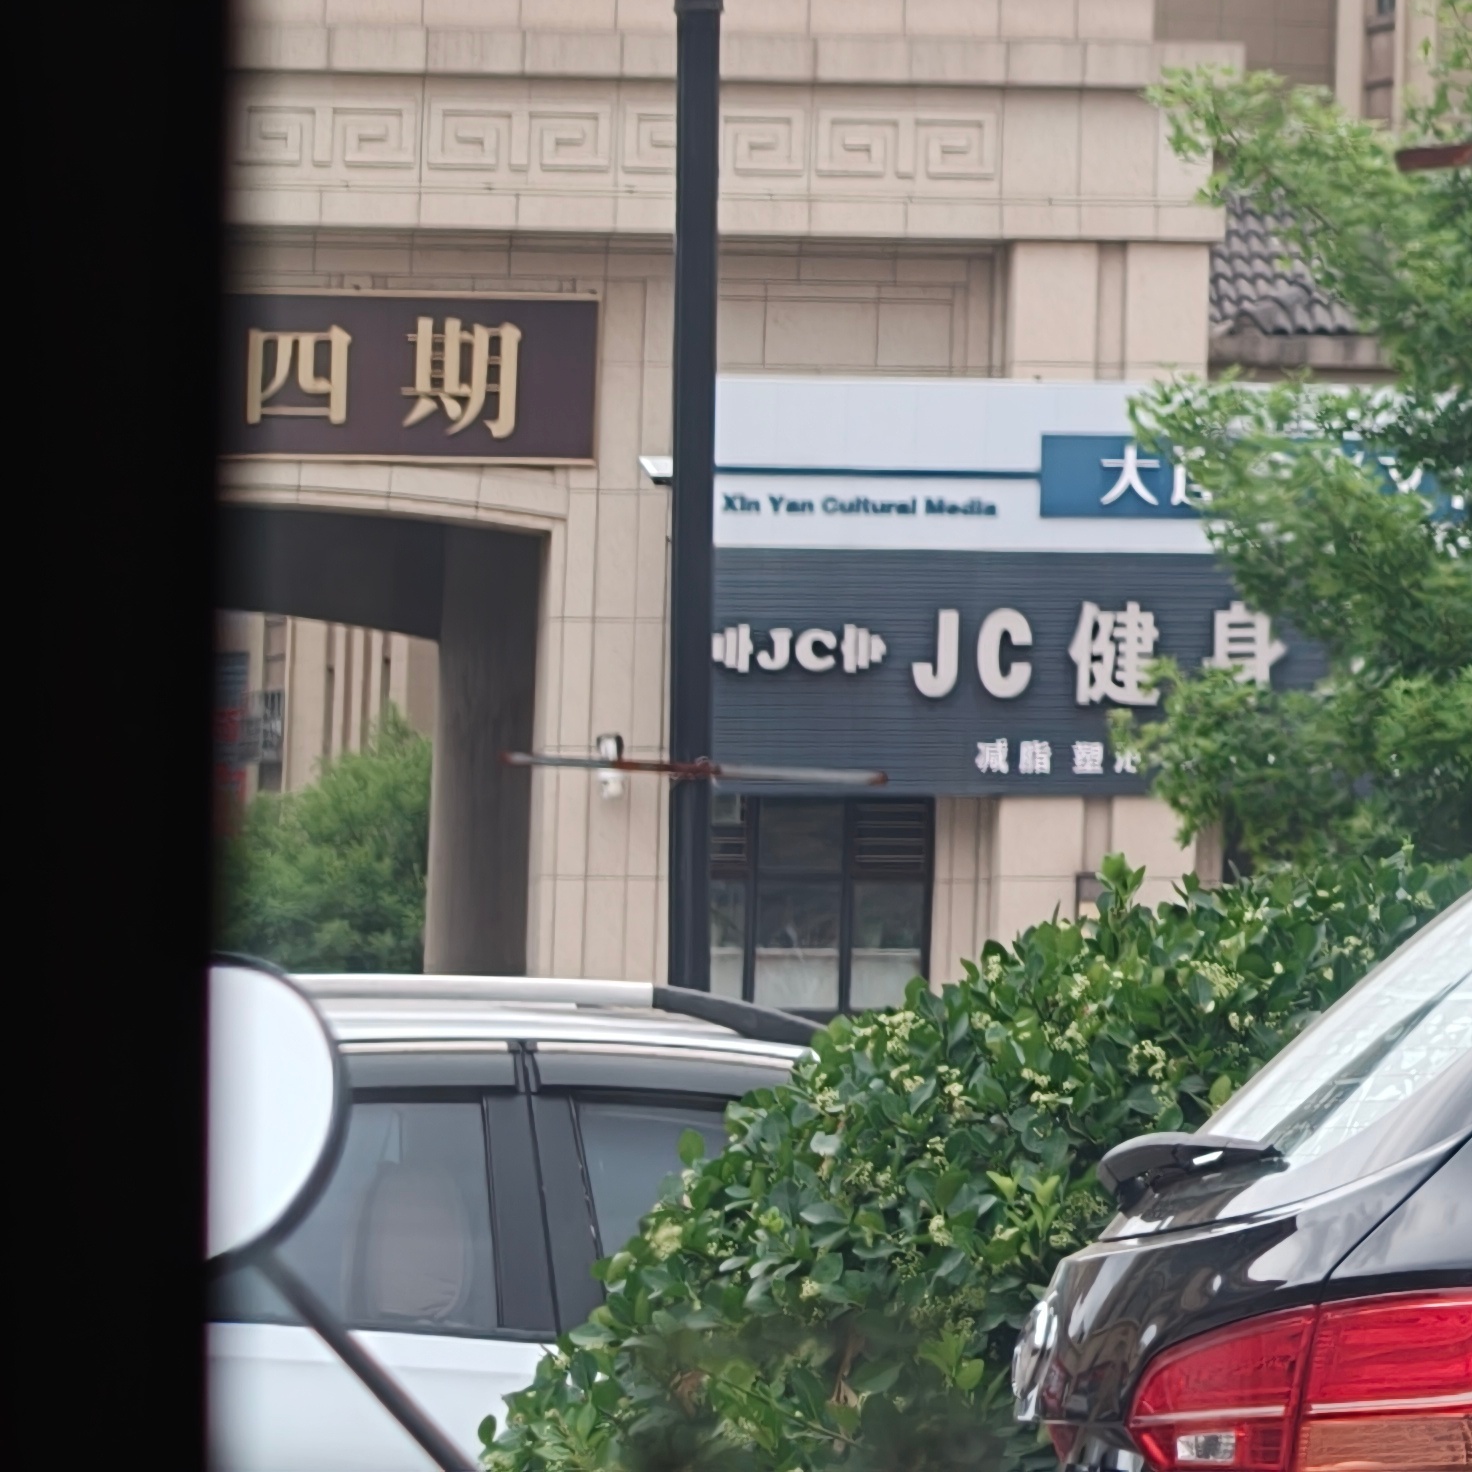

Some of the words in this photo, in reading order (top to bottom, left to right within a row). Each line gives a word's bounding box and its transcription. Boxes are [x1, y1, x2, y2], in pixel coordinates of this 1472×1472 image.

[247, 317, 521, 438] 四期
[821, 497, 917, 517] Cultural
[924, 498, 997, 517] Media
[756, 627, 837, 673] JC
